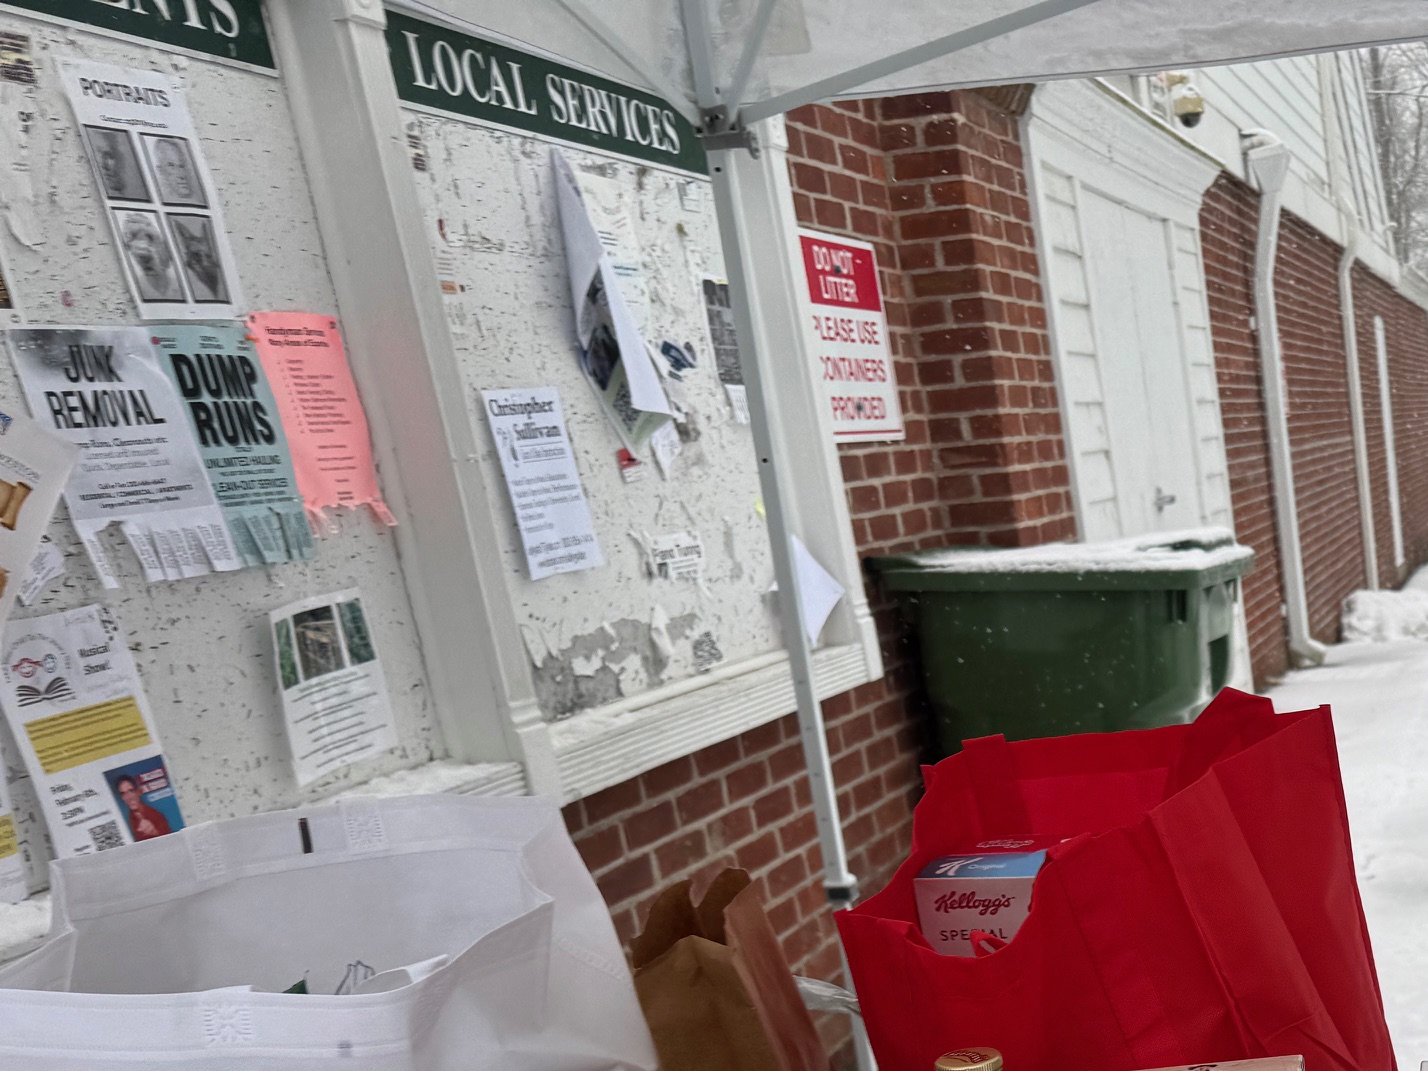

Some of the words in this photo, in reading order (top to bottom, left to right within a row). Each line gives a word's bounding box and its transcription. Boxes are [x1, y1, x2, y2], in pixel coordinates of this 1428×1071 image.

[79, 76, 171, 108] PORTRAITS
[401, 31, 538, 115] LOCAL
[545, 73, 681, 155] SERVICES
[812, 245, 831, 271] DO
[831, 249, 855, 275] NOT
[818, 274, 860, 303] LITTER
[856, 320, 880, 345] USE
[64, 344, 125, 383] JUNK
[169, 353, 259, 400] DUMP
[820, 356, 887, 382] ONTAINERS
[44, 389, 167, 430] REMOVAL
[488, 397, 555, 419] Christopher
[831, 396, 887, 420] PROVIDED
[189, 400, 277, 448] RUNS
[512, 421, 562, 441] Sullivan
[968, 863, 1006, 871] Original
[935, 891, 1012, 915] Kellogg's
[940, 928, 1008, 941] SPEAL
